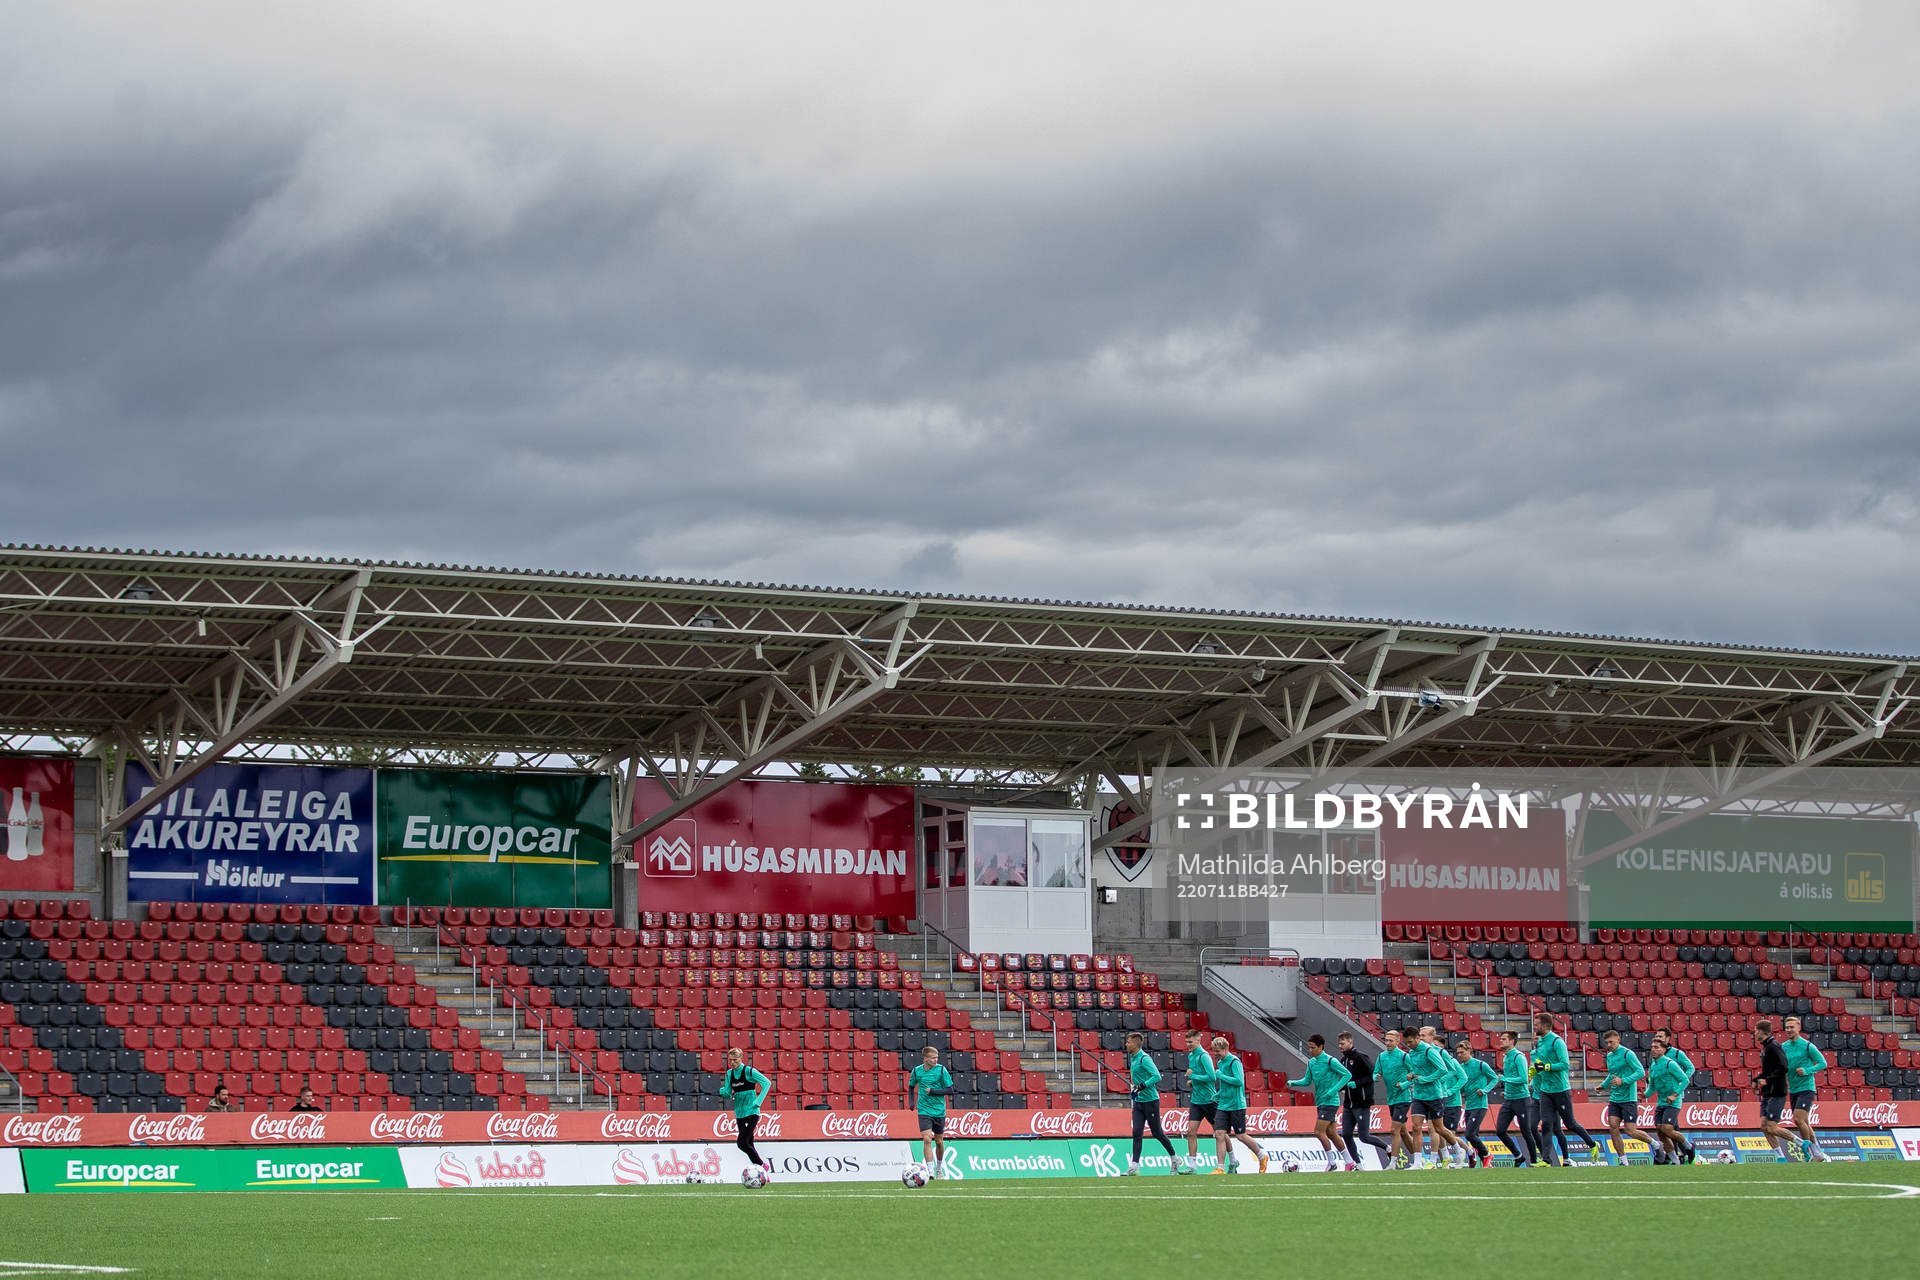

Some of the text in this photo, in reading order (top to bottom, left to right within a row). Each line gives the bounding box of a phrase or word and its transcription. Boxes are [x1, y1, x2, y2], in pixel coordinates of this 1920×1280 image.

[131, 819, 360, 853] AKUREYRAR
[403, 815, 580, 863] Europcar
[702, 839, 906, 875] HÚSASMIÐJAN
[1616, 847, 1832, 875] KOLEFNISJAFNAÐU
[205, 859, 285, 888] Höldur
[1390, 858, 1560, 892] HÚSASMIÐJAN
[1780, 882, 1833, 899] á olis.is
[250, 1113, 327, 1140] Coca-Cola
[370, 1112, 444, 1139] Coca-Cola
[486, 1112, 559, 1138] Coca-Cola
[601, 1112, 673, 1138] Coca-Cola
[822, 1112, 889, 1137] Coca-Cola
[1030, 1111, 1095, 1135] Coca-Cola
[1686, 1104, 1739, 1127] Coca-Cola
[1850, 1102, 1899, 1125] Coca-Cola
[4, 1114, 84, 1143] Coca-Cola
[128, 1114, 208, 1142] Coca-Cola
[66, 1160, 180, 1186] Europcar
[256, 1159, 364, 1184] Europcar
[767, 1156, 860, 1174] LOGOS
[968, 1154, 1066, 1171] Krambúðin
